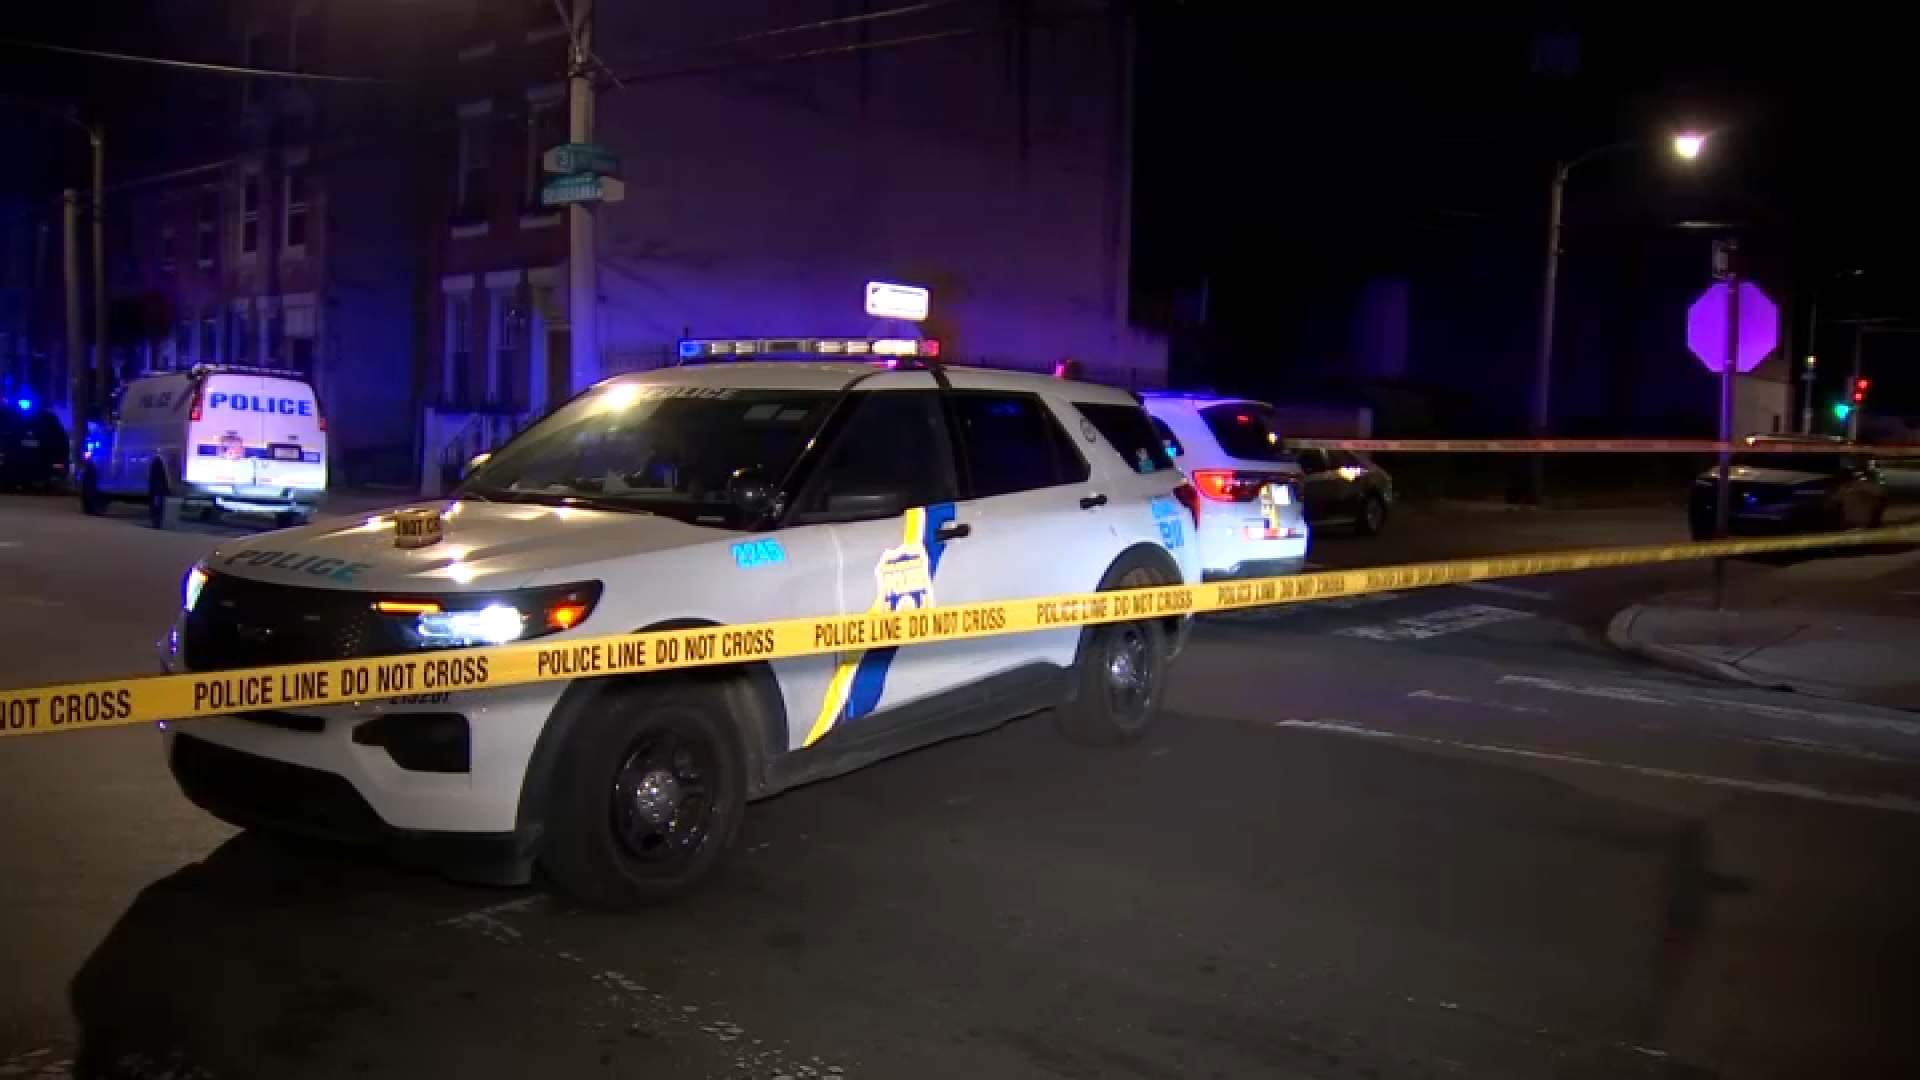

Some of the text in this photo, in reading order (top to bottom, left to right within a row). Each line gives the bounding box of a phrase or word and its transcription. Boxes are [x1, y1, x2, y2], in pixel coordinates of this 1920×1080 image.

[210, 392, 312, 416] POLICE
[224, 550, 375, 585] POLICE
[1114, 595, 1129, 617] DO
[1133, 593, 1153, 614] NOT
[813, 607, 1006, 648] POLICE LINE DO NOT CROSS
[538, 628, 774, 676] POLICE LINE DO NOT CROSS
[194, 656, 489, 710] POLICE LINE DO NOT CROSS
[50, 688, 132, 725] CROSS
